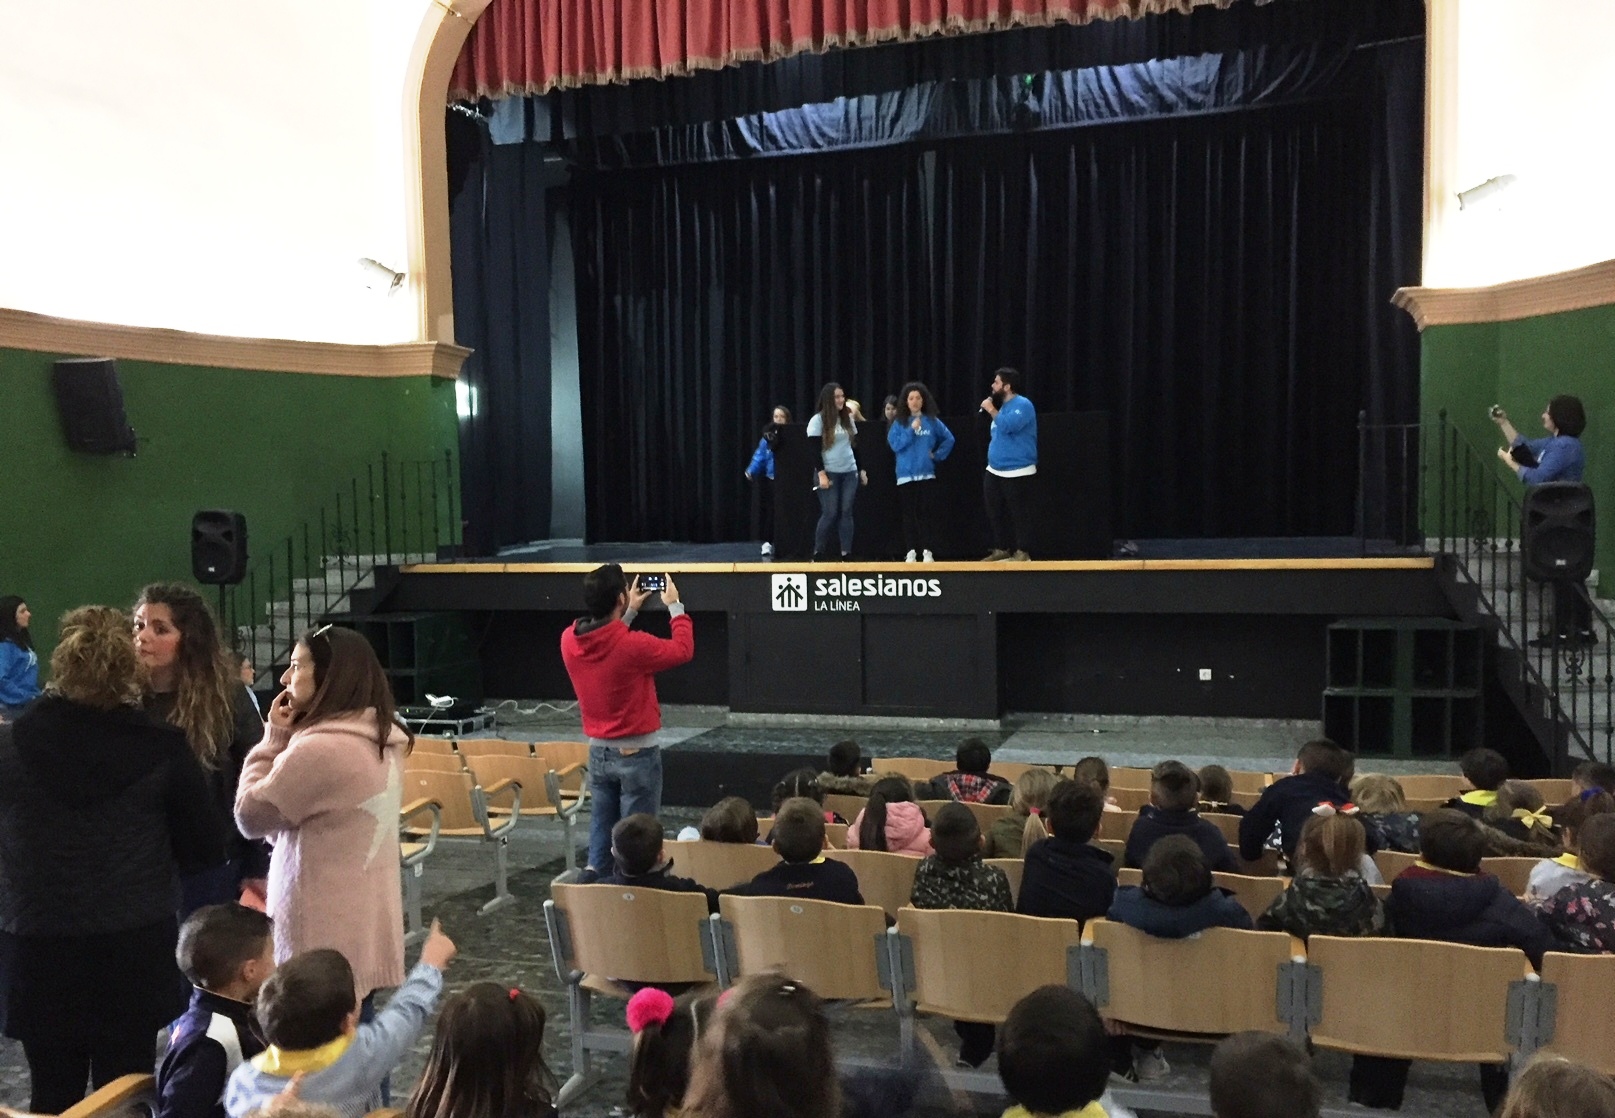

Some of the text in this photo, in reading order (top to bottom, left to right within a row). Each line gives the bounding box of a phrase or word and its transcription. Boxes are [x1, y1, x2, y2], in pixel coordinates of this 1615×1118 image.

[814, 573, 942, 597] salesianos
[814, 599, 861, 611] LA LÍNEA
